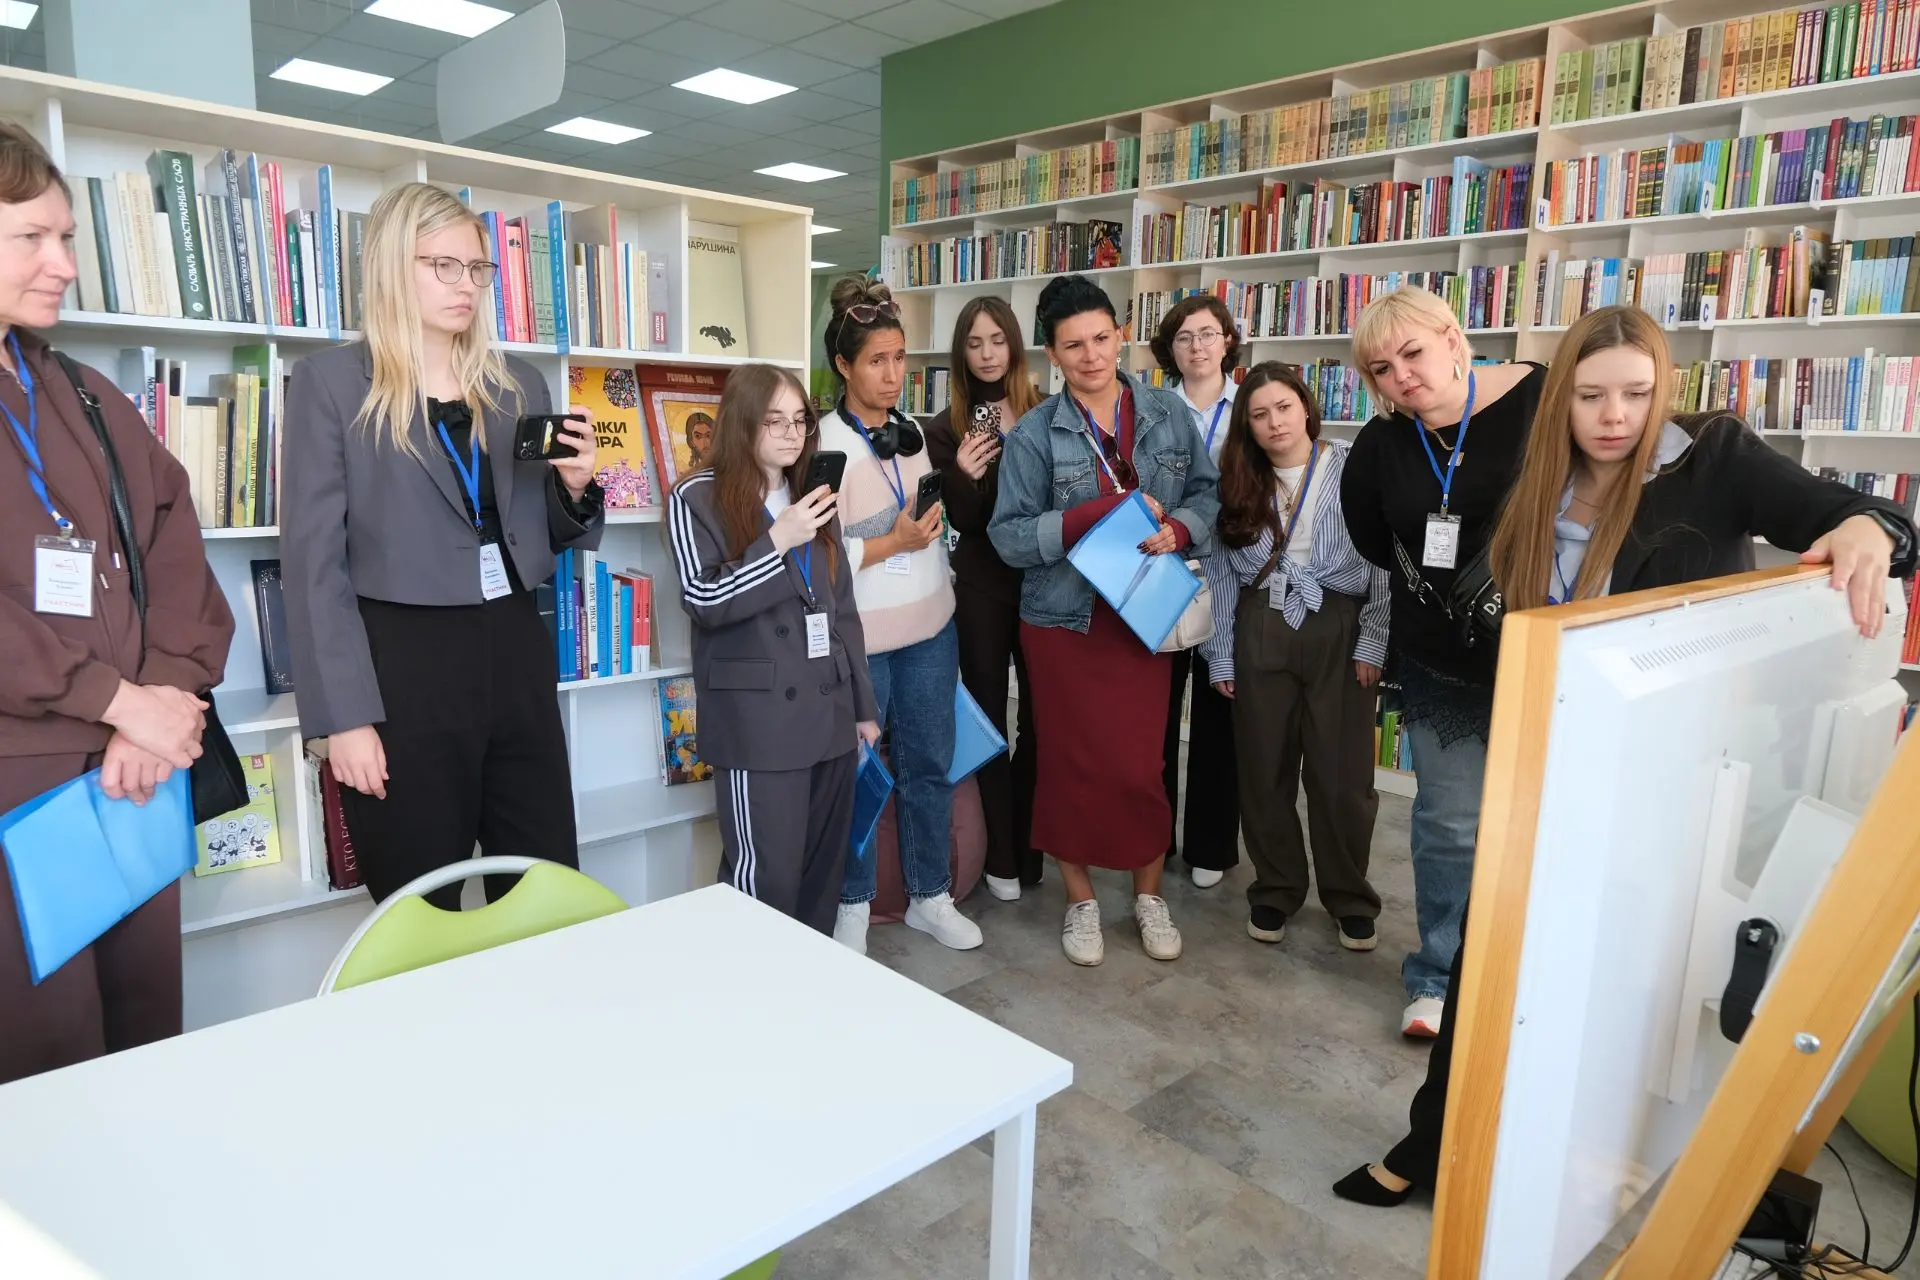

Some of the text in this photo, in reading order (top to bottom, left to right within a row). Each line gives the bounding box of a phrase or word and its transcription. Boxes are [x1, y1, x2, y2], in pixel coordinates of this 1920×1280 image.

[172, 158, 200, 292] СЛОВАРЬ ИНОСТРАННЫХ СЛОВ
[1668, 304, 1675, 322] Р
[1702, 304, 1709, 322] С
[592, 422, 627, 433] ЫКИ
[218, 445, 226, 502] ПАХОМОВ
